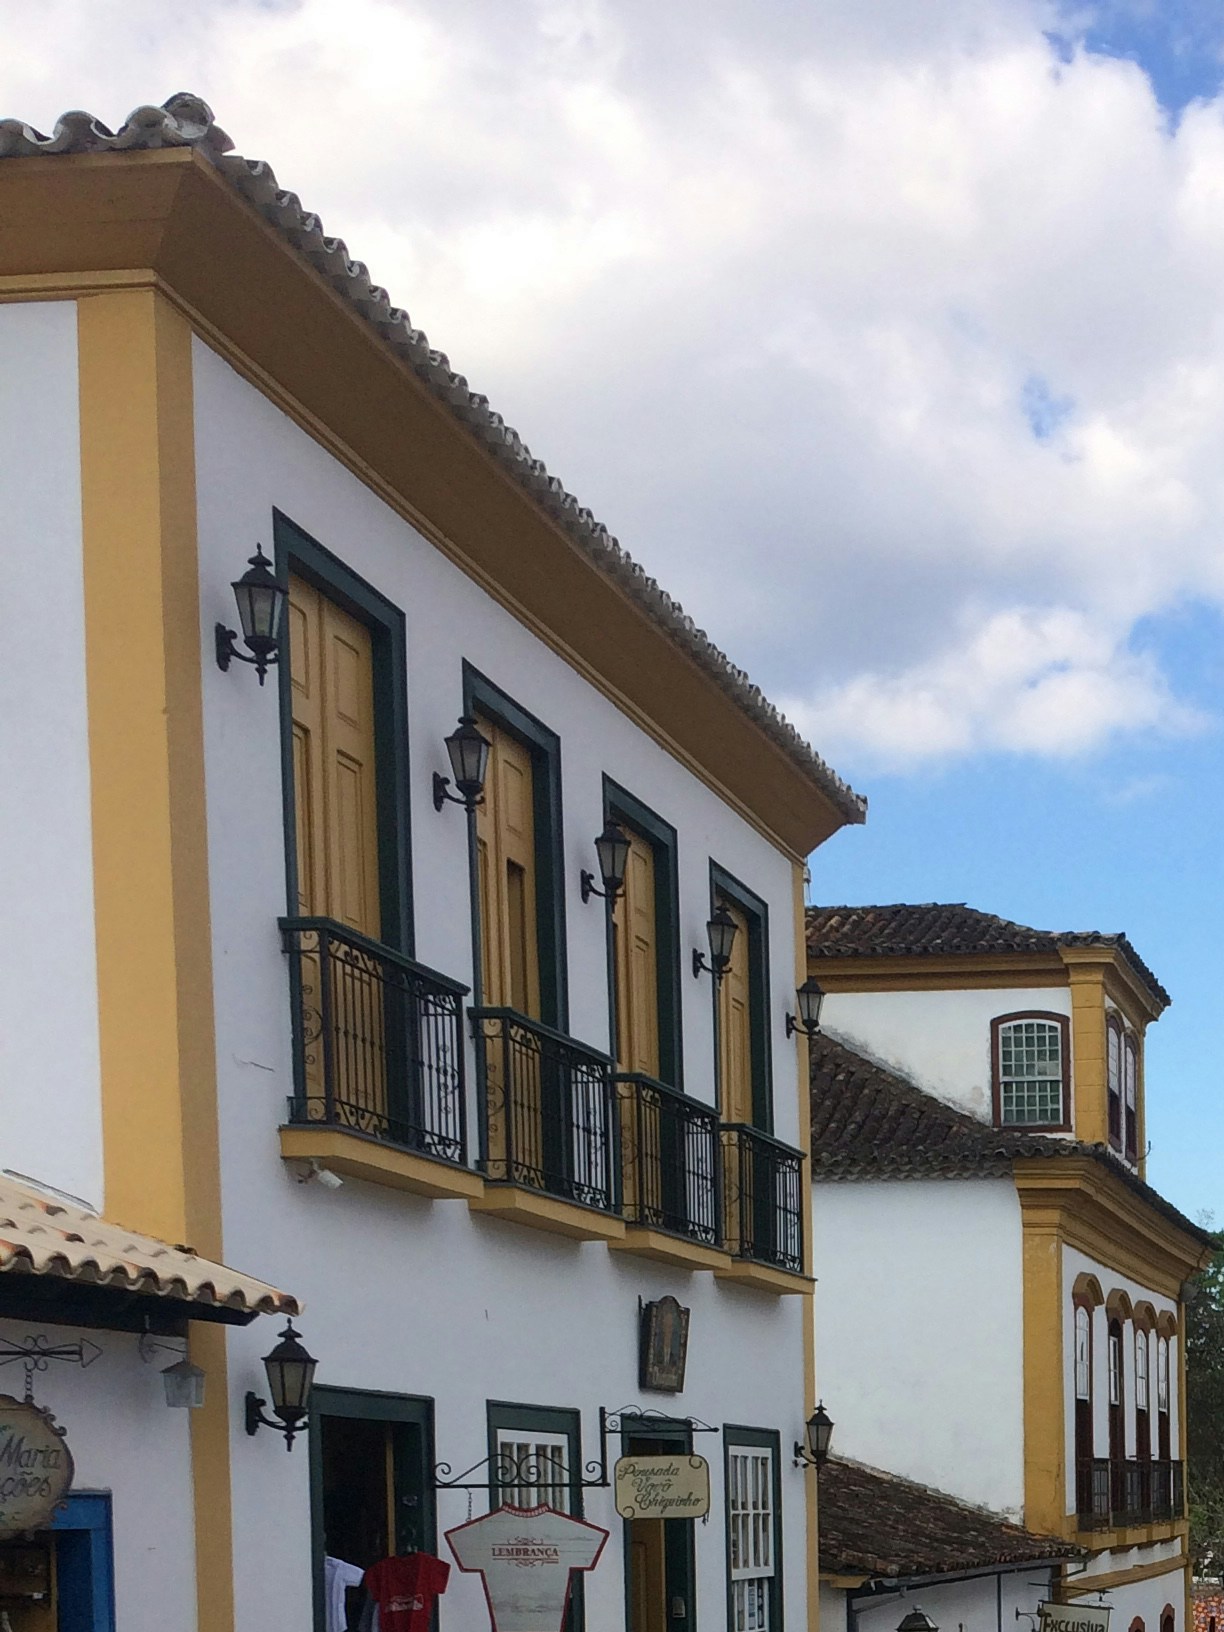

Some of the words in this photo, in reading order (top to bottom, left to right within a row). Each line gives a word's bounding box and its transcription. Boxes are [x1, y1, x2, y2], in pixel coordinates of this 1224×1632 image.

[617, 1461, 681, 1481] Pousada
[0, 1470, 52, 1501] ções
[491, 1547, 560, 1558] LEMBRANÇA
